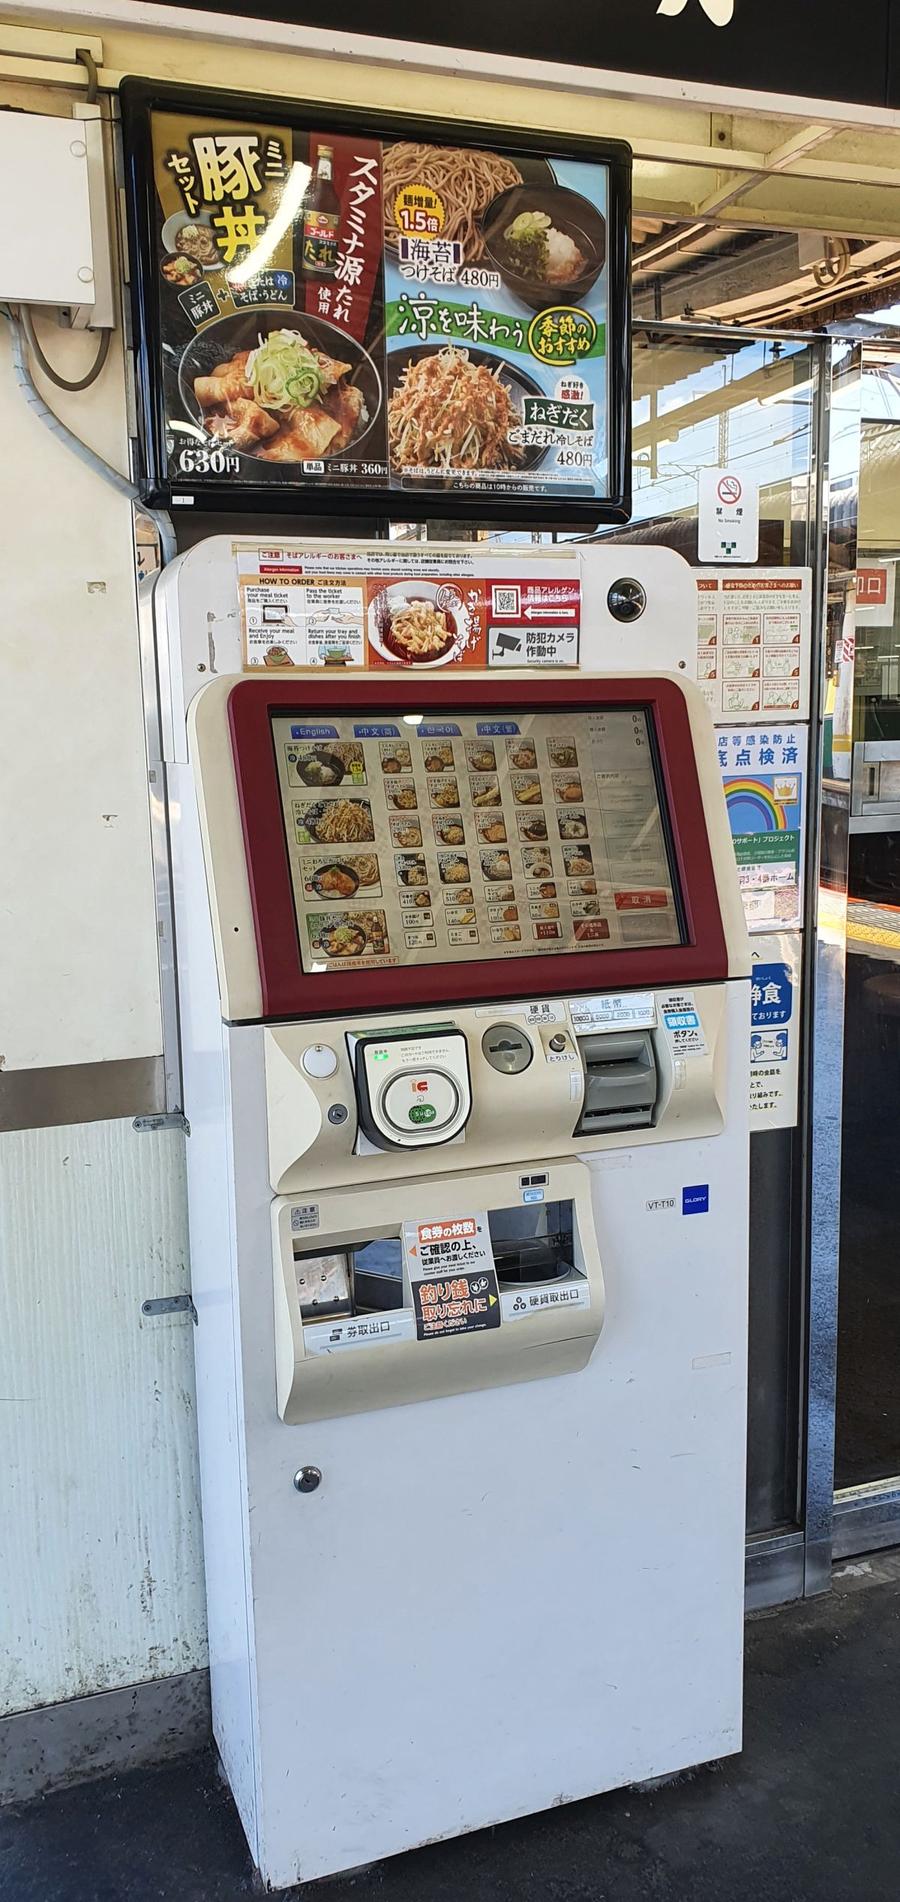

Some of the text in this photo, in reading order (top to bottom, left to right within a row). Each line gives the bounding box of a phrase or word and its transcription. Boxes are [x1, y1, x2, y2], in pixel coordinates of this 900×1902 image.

[264, 140, 285, 177] ミニ
[167, 153, 199, 214] セット
[192, 135, 266, 263] 豚丼
[400, 209, 440, 232] 1.5倍
[333, 155, 378, 322] スタミナ源たれ
[410, 238, 452, 263] 海苔
[400, 263, 499, 287] つけそば 480円
[189, 291, 205, 303] ミニ
[318, 286, 331, 314] 使用
[190, 299, 214, 320] 豚丼
[399, 292, 524, 347] 涼を味わう
[540, 314, 586, 336] 季節の
[538, 337, 591, 356] おすすめ
[530, 401, 588, 428] ねぎだく
[179, 449, 240, 473] 630円
[556, 450, 593, 467] 480円
[291, 578, 315, 586] ORDER
[525, 632, 575, 644] 防犯カメラ
[526, 645, 557, 658] 作動中
[300, 727, 331, 736] English
[718, 733, 796, 747] 店等感染防止
[751, 1010, 787, 1021] ております
[549, 1054, 575, 1062] とりけし
[750, 1068, 781, 1077] 時の会話を
[749, 1090, 783, 1099] り組みです。
[648, 1196, 707, 1210] VT-T10 GLORY
[420, 1239, 477, 1256] ご確認の上、
[419, 1278, 470, 1305] 釣り銭
[528, 1289, 579, 1306] 硬貨取出口
[421, 1297, 488, 1322] 取り忘れに
[346, 1321, 391, 1338] 券取出口
